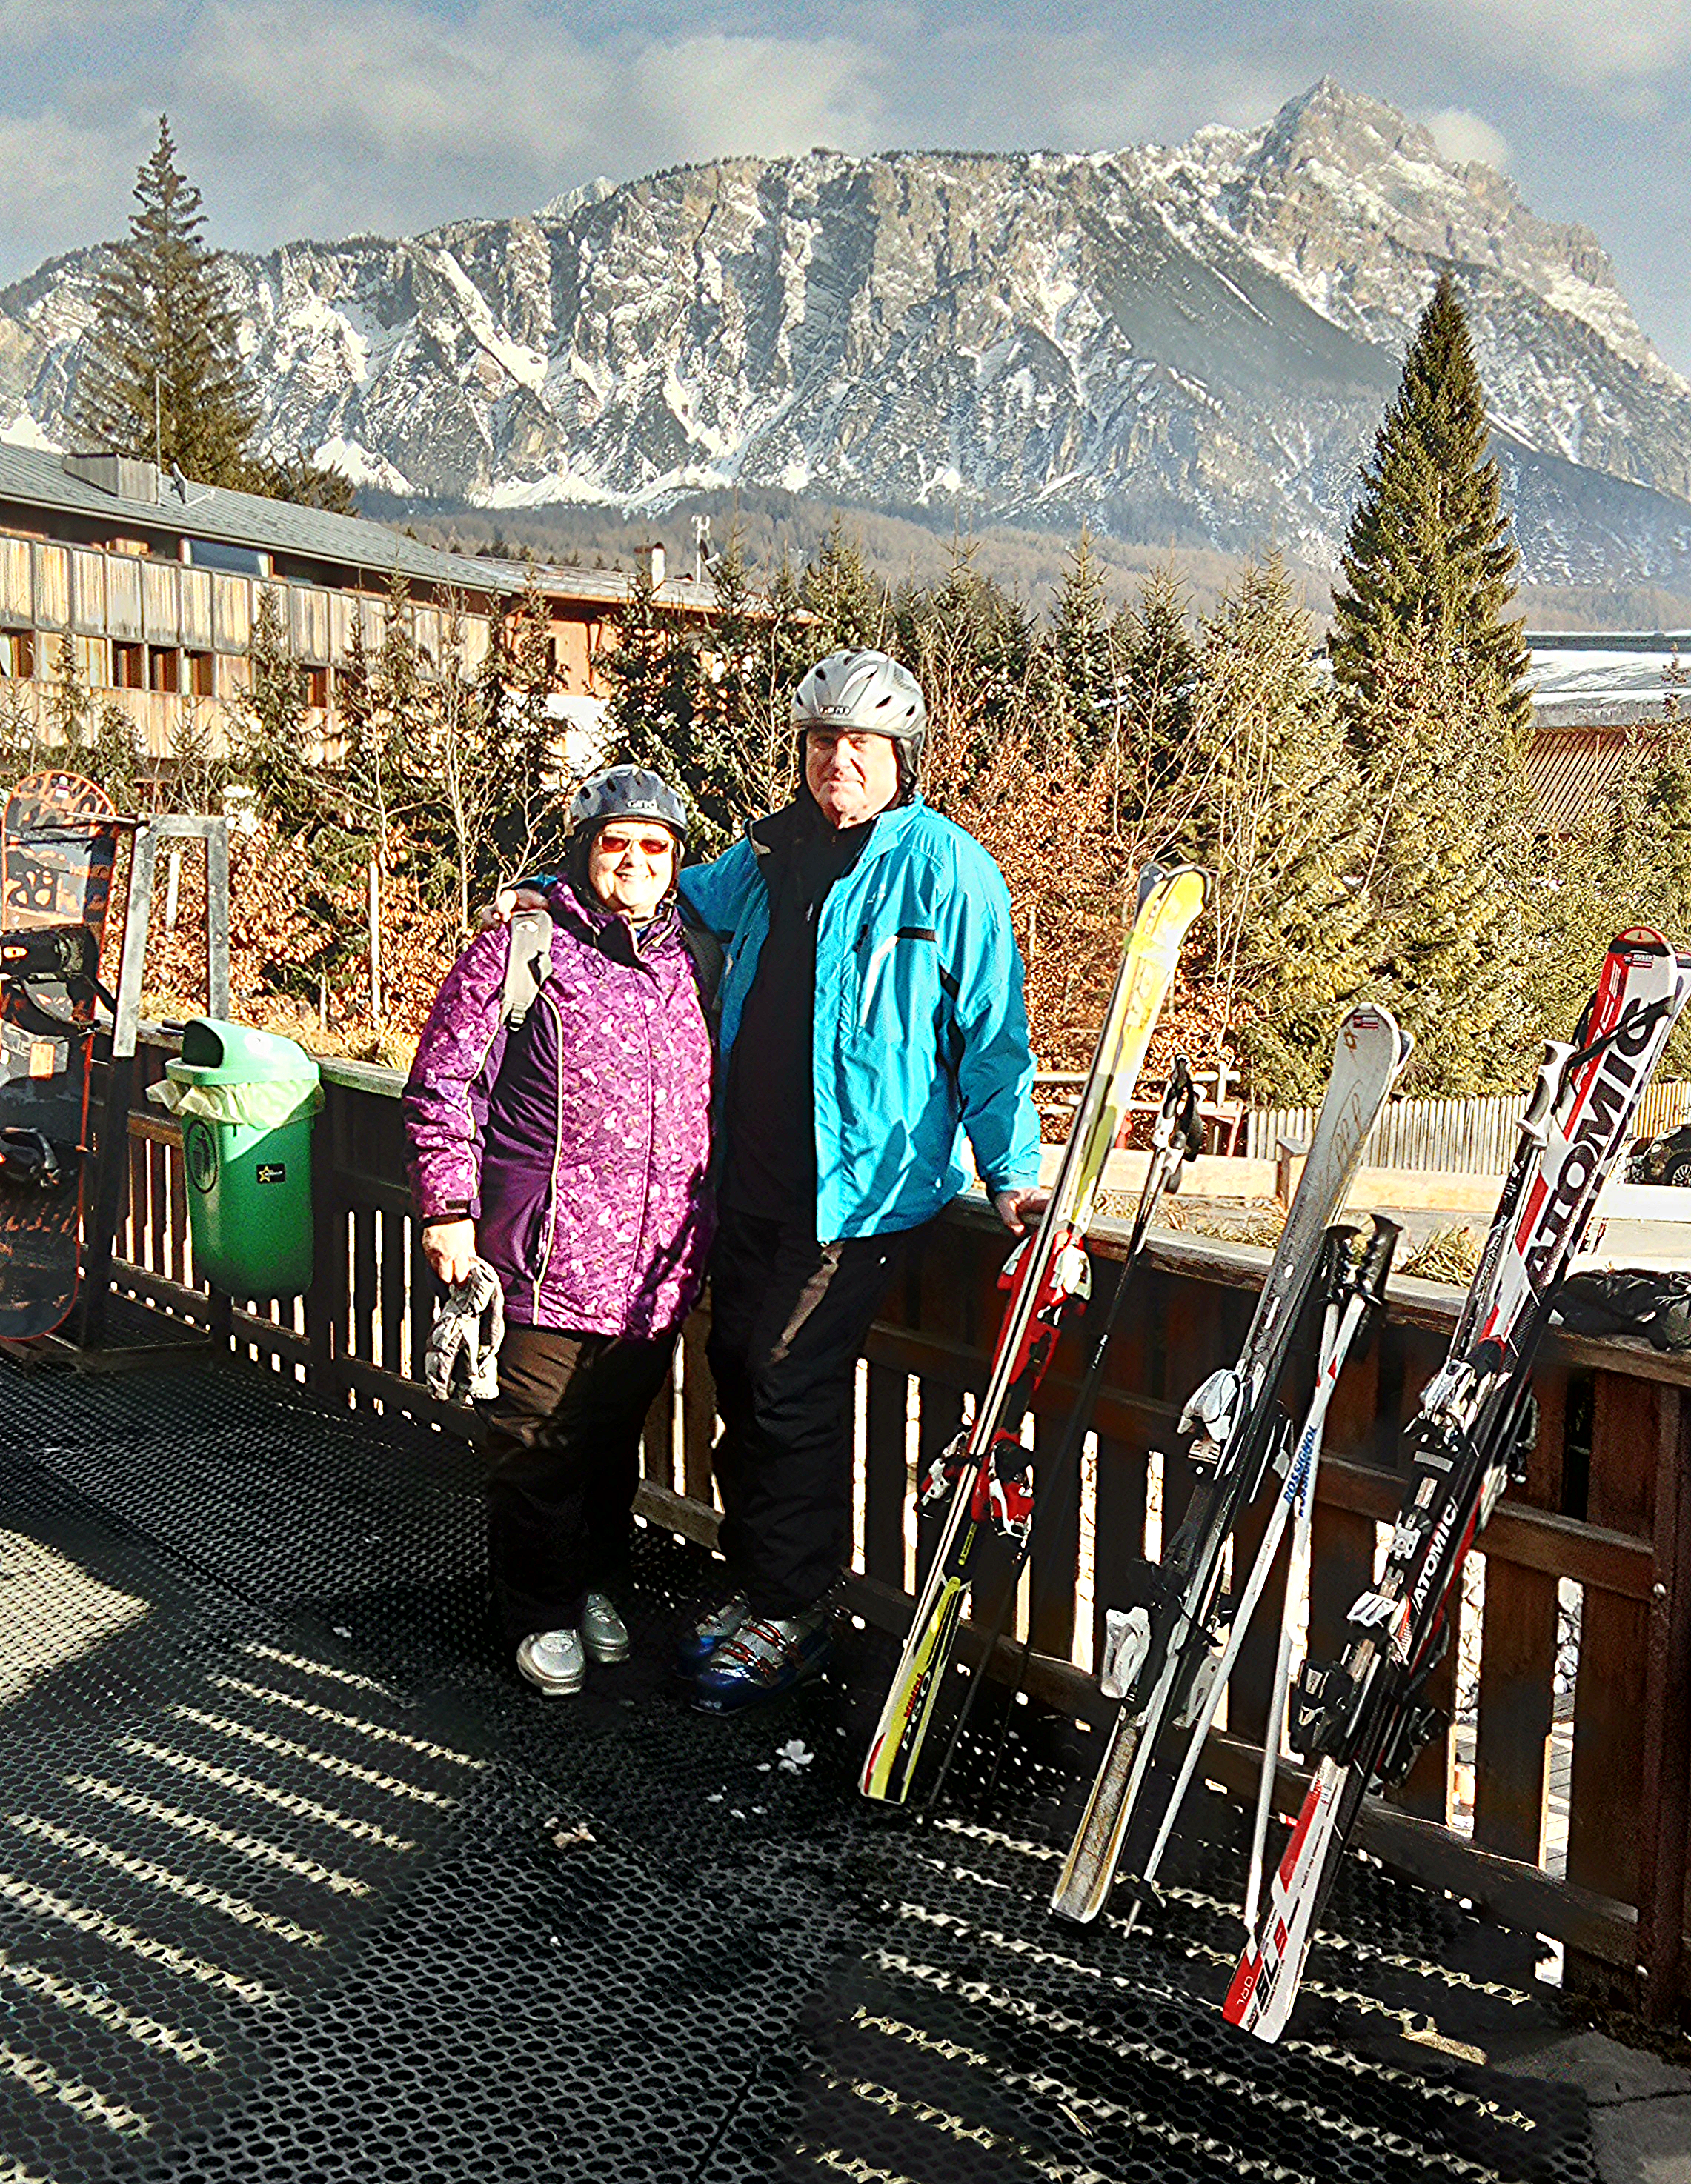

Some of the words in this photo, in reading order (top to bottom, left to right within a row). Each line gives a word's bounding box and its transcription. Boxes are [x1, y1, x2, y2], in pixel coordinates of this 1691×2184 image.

[1525, 997, 1658, 1288] ATOMIC
[1283, 1425, 1318, 1505] ROSSIGNOL
[1413, 1505, 1458, 1610] ATOMIC
